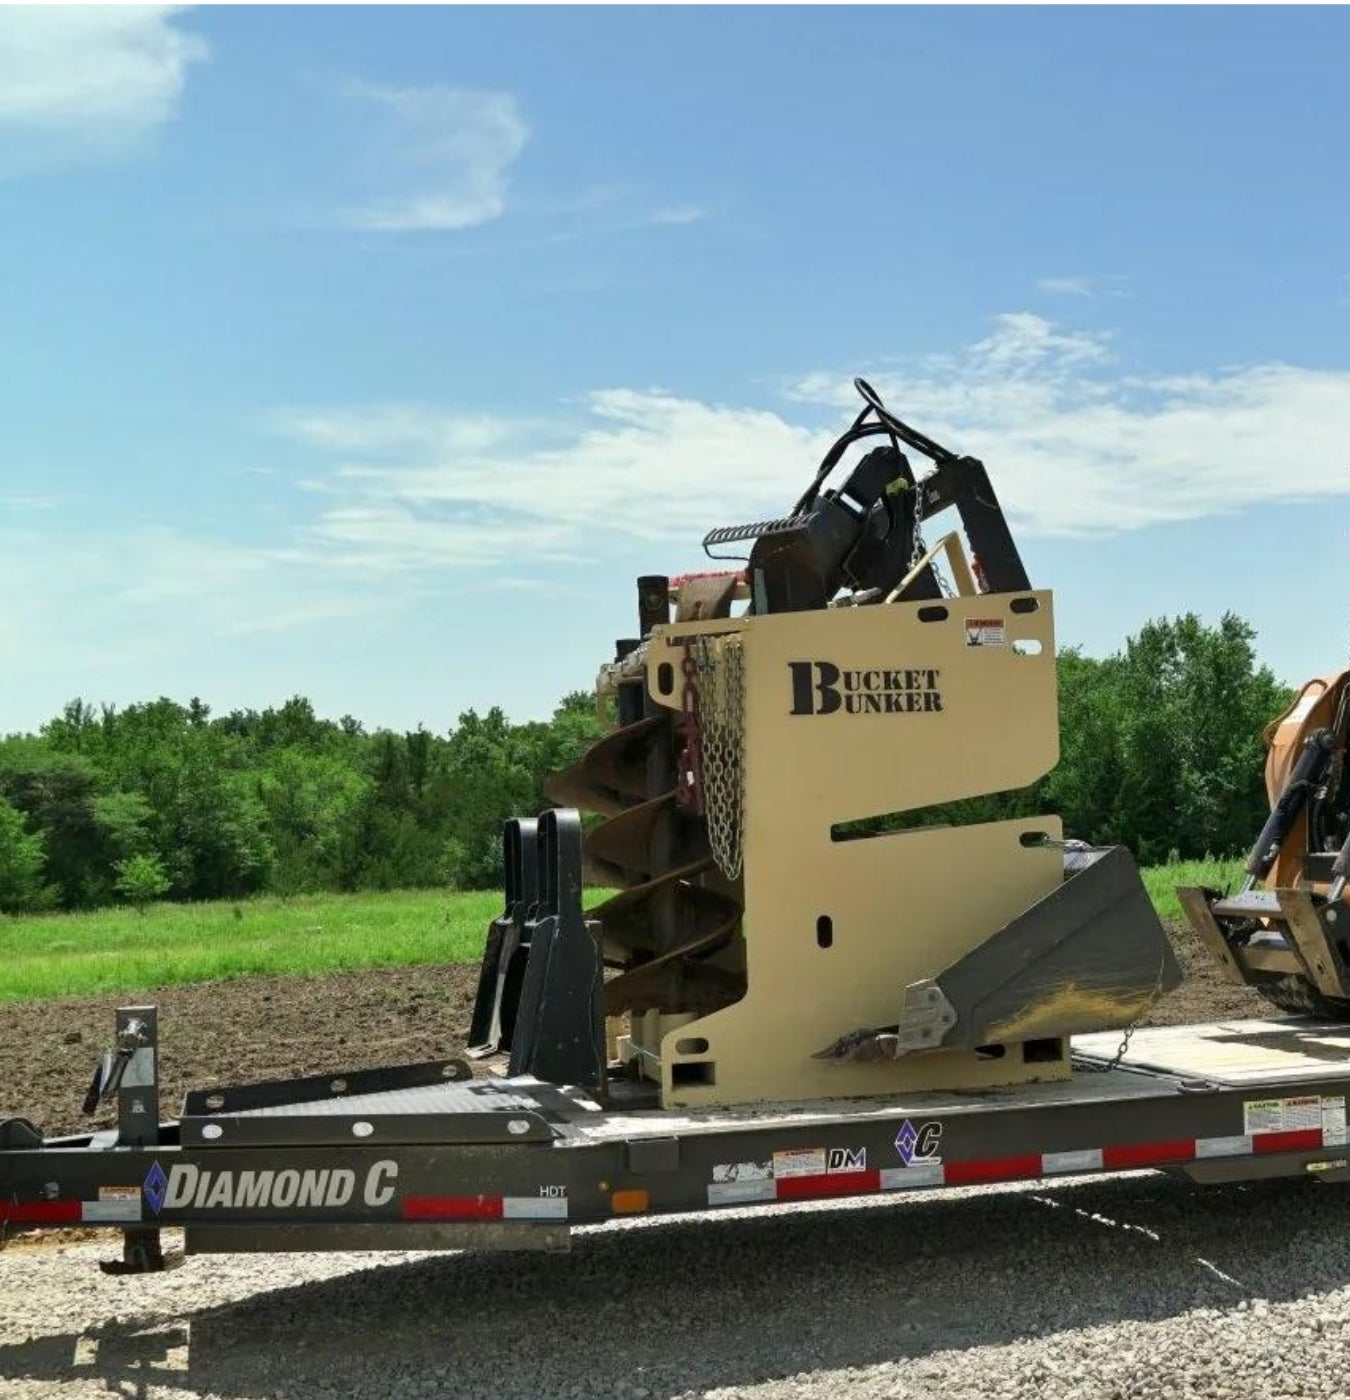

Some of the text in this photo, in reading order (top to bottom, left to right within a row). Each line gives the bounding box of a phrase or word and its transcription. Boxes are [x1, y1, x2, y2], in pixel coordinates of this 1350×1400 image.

[787, 661, 940, 692] BUCKET
[914, 1121, 942, 1158] C
[830, 1147, 866, 1169] DM
[163, 1160, 399, 1208] DIAMOND C
